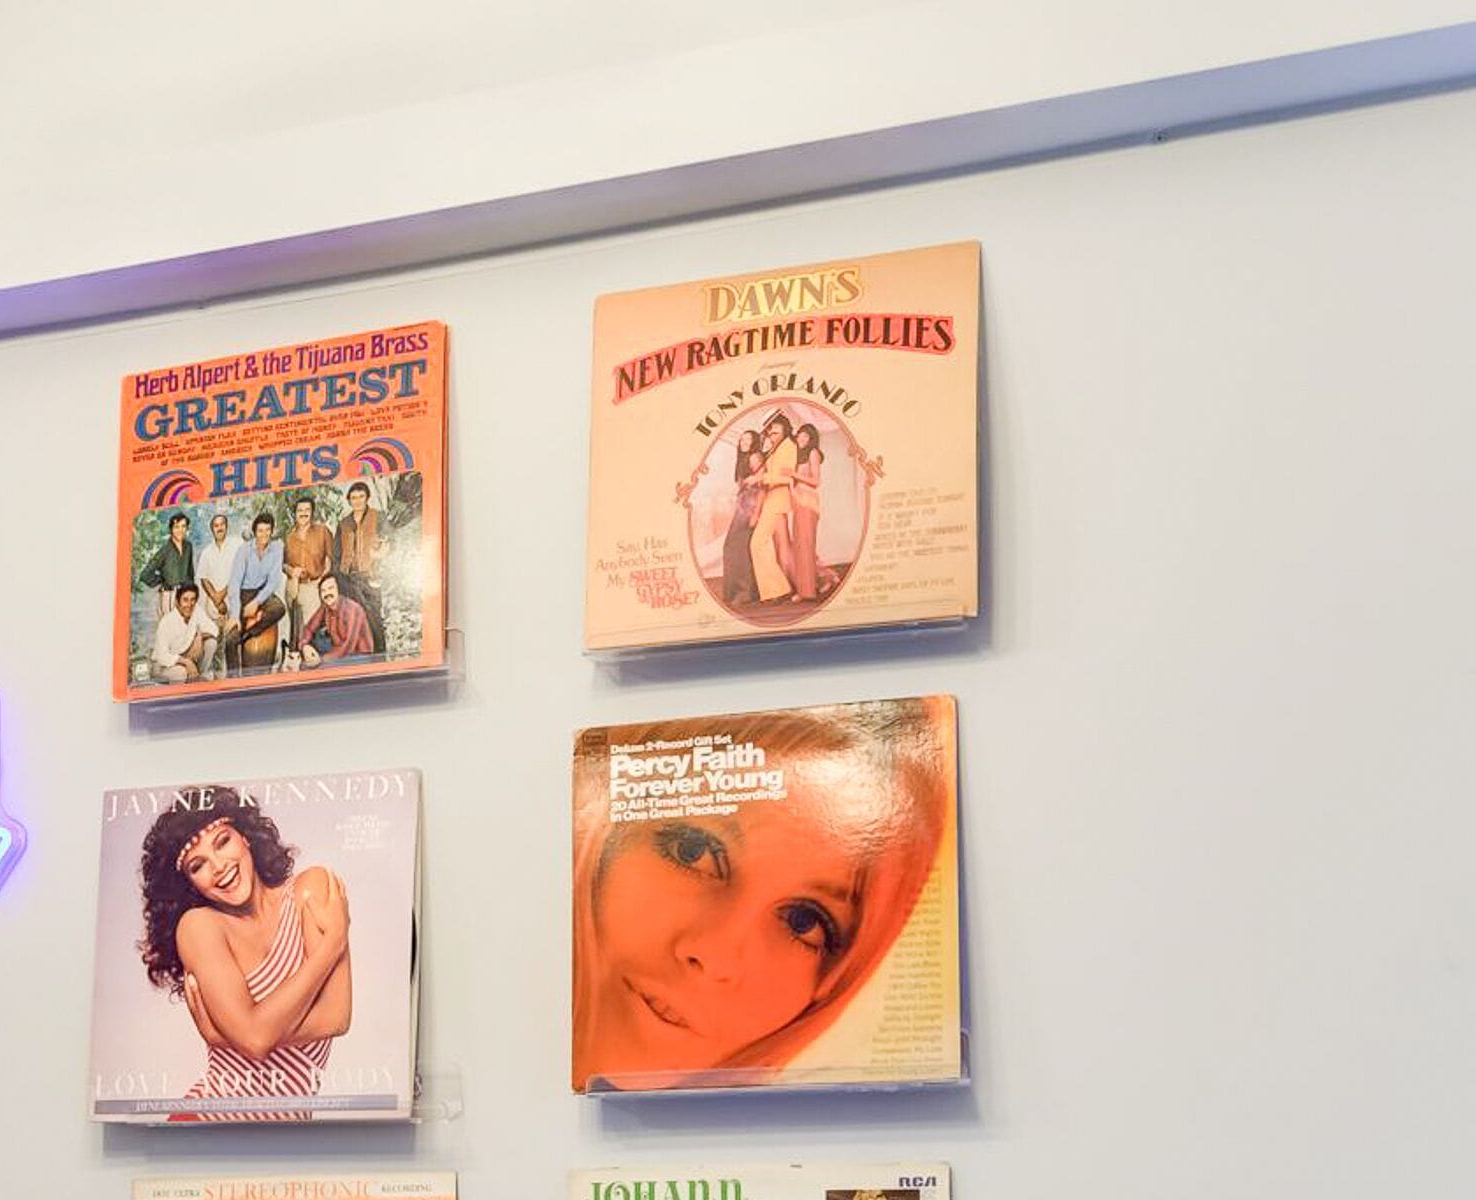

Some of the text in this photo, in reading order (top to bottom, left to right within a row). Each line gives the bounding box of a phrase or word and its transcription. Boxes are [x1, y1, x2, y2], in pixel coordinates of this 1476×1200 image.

[707, 269, 860, 323] DAWN'S
[135, 331, 429, 398] Herb Alpert & the Tijuana Brass
[618, 316, 954, 394] NEW RAGTIME FOLLIES
[134, 359, 427, 442] GREATEST
[693, 372, 862, 438] TONY ORLANDO
[210, 443, 340, 498] HITS
[610, 742, 765, 779] Percy Faith
[610, 769, 784, 799] Forever Young
[107, 773, 411, 822] JAYNE KENNEDY
[624, 809, 648, 821] One
[650, 806, 684, 818] Great
[686, 804, 739, 816] Package
[628, 797, 679, 809] All-Time
[680, 794, 714, 806] Great
[716, 789, 788, 802] Recordings
[205, 1179, 374, 1200] STEREOPHONIC
[899, 1176, 936, 1187] RCA
